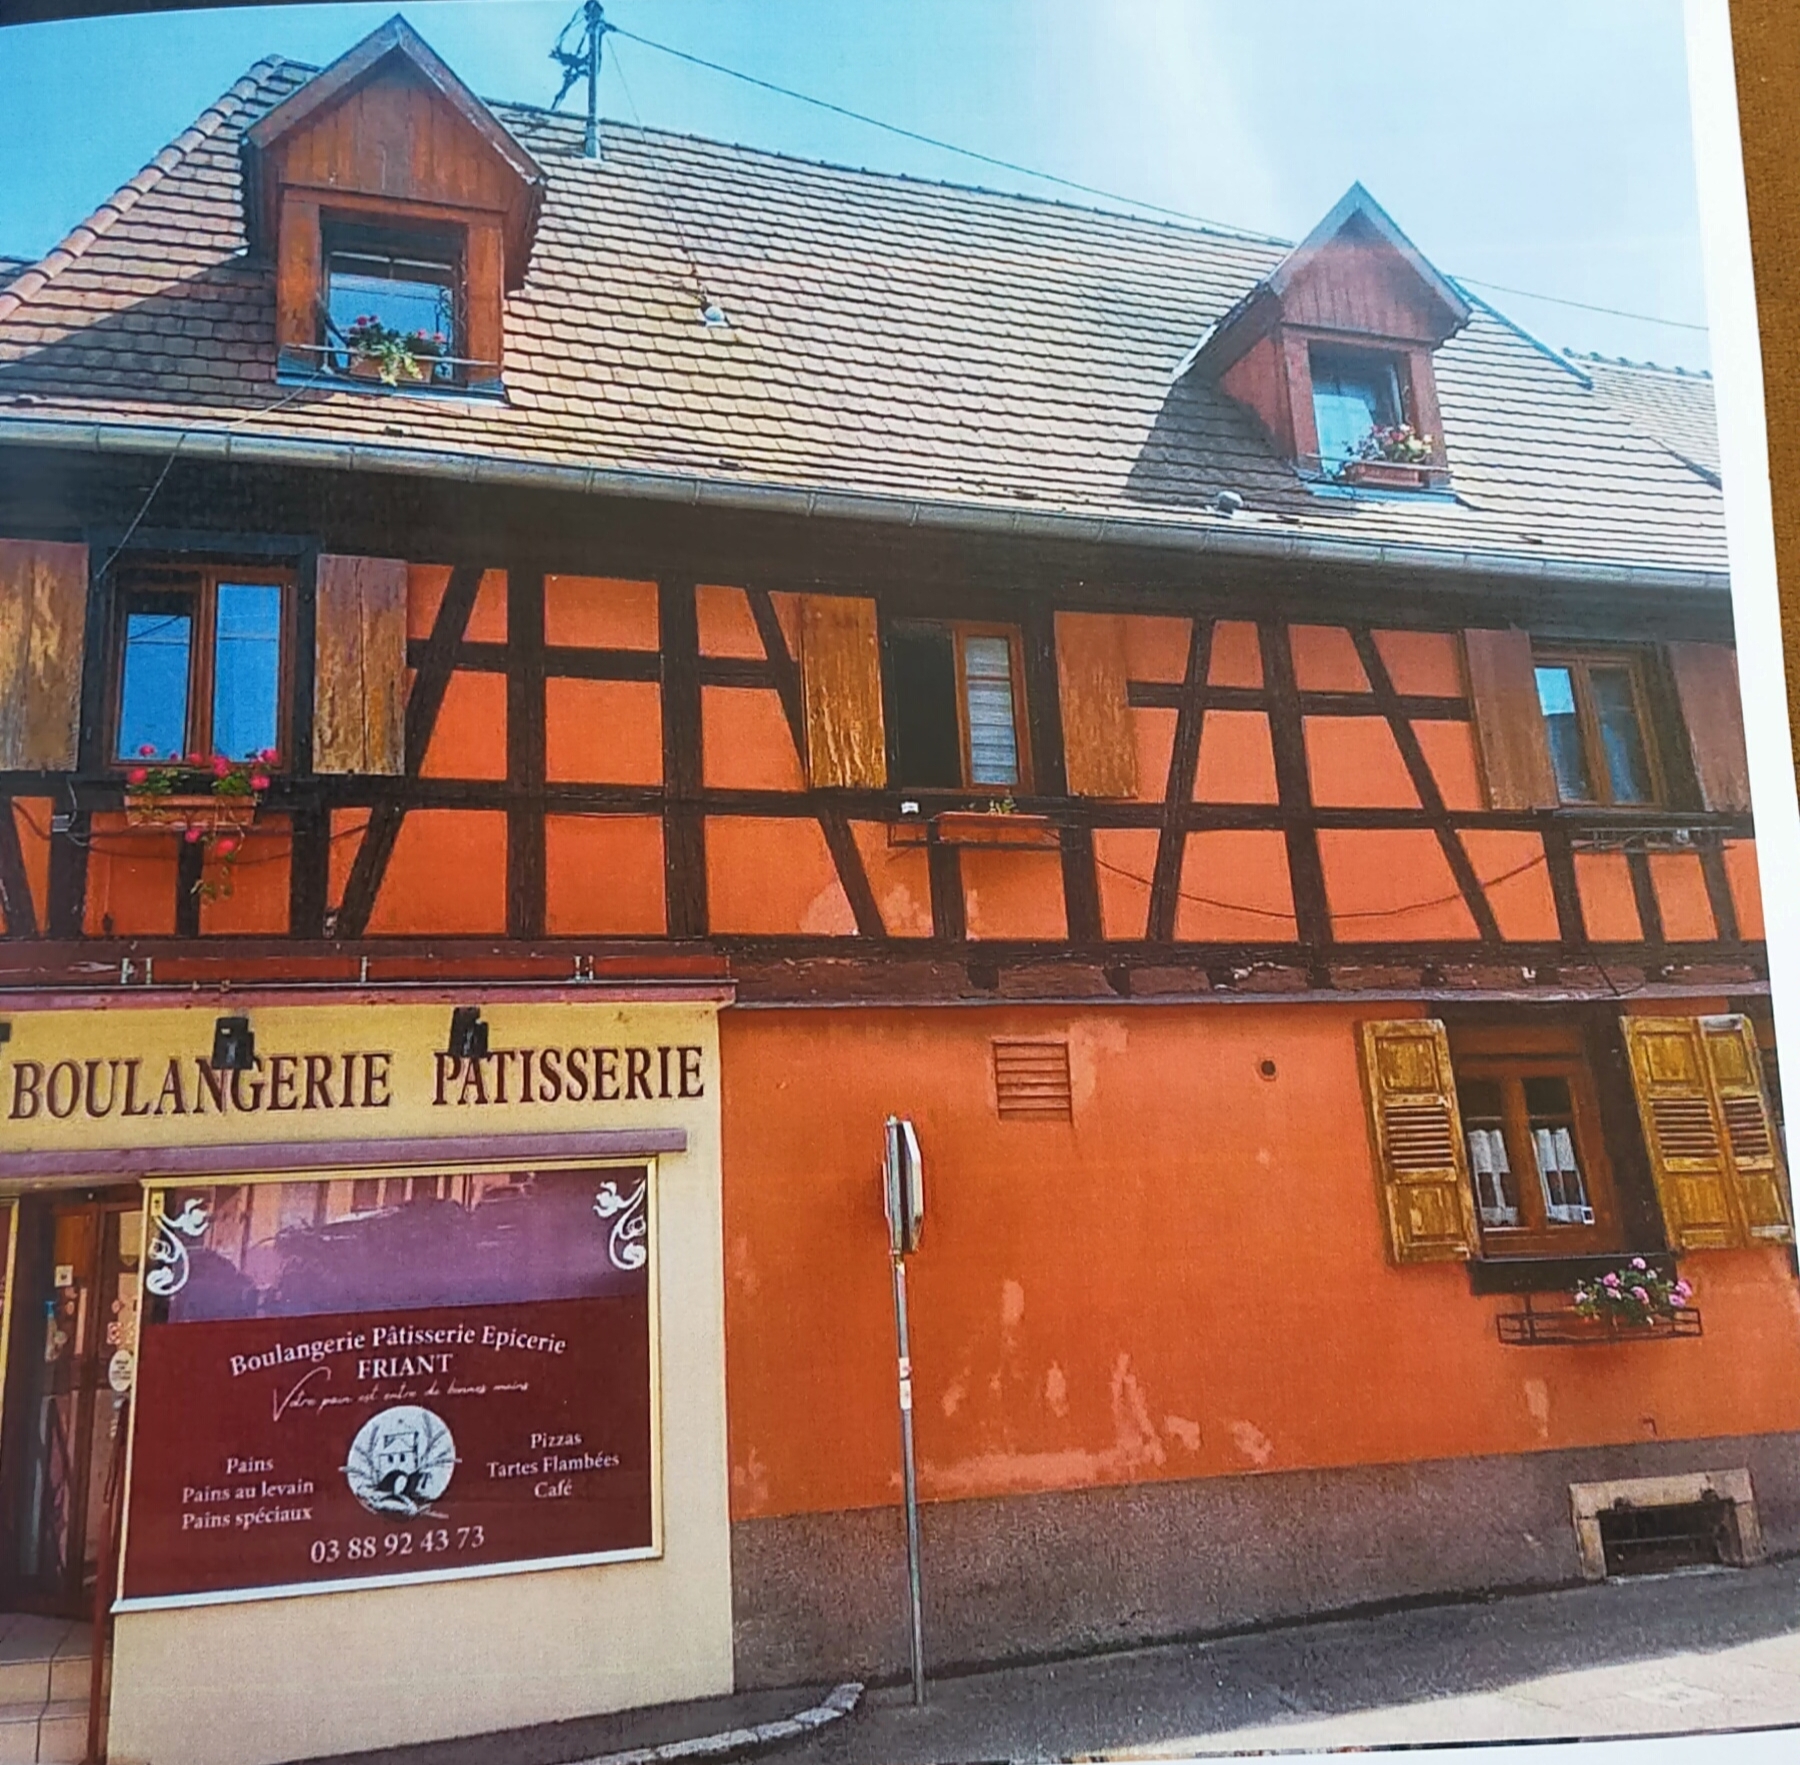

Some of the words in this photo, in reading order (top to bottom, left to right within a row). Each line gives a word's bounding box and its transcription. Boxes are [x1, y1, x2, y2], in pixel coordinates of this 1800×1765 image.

[8, 1053, 392, 1119] BOULANGERIE
[432, 1046, 704, 1105] PATISSERIE
[229, 1330, 366, 1376] Boulangerie
[372, 1323, 476, 1347] Pâtisserie
[480, 1325, 567, 1355] Epicerie
[357, 1353, 454, 1379] FRIANT
[530, 1432, 582, 1449] Pizzas
[225, 1456, 275, 1475] Pains
[486, 1461, 539, 1478] Tartes
[542, 1450, 620, 1474] Flambées
[182, 1485, 231, 1504] Pains
[234, 1485, 257, 1499] au
[260, 1478, 314, 1498] levain
[533, 1479, 573, 1498] Café
[181, 1511, 231, 1530] Pains
[234, 1505, 314, 1531] spéciaux
[310, 1539, 340, 1563] 03
[347, 1535, 377, 1560] 88
[383, 1532, 413, 1556] 92
[419, 1528, 449, 1552] 43
[456, 1524, 485, 1549] 73
